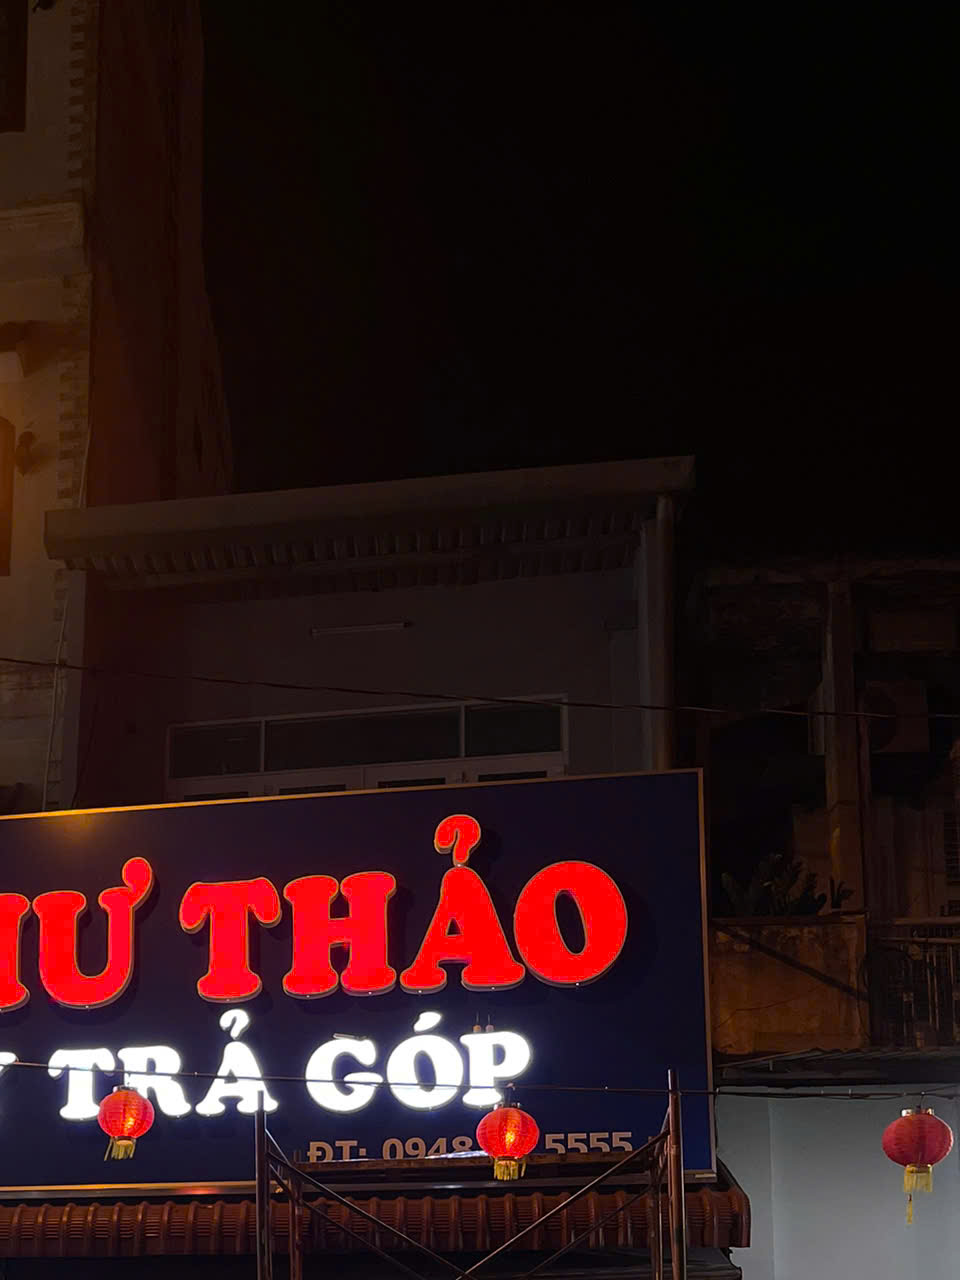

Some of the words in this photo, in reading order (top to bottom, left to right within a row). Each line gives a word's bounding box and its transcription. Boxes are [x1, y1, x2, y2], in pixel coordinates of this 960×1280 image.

[178, 814, 628, 1000] THẢO
[47, 1007, 279, 1121] TRẢ
[304, 1011, 532, 1113] GÓP
